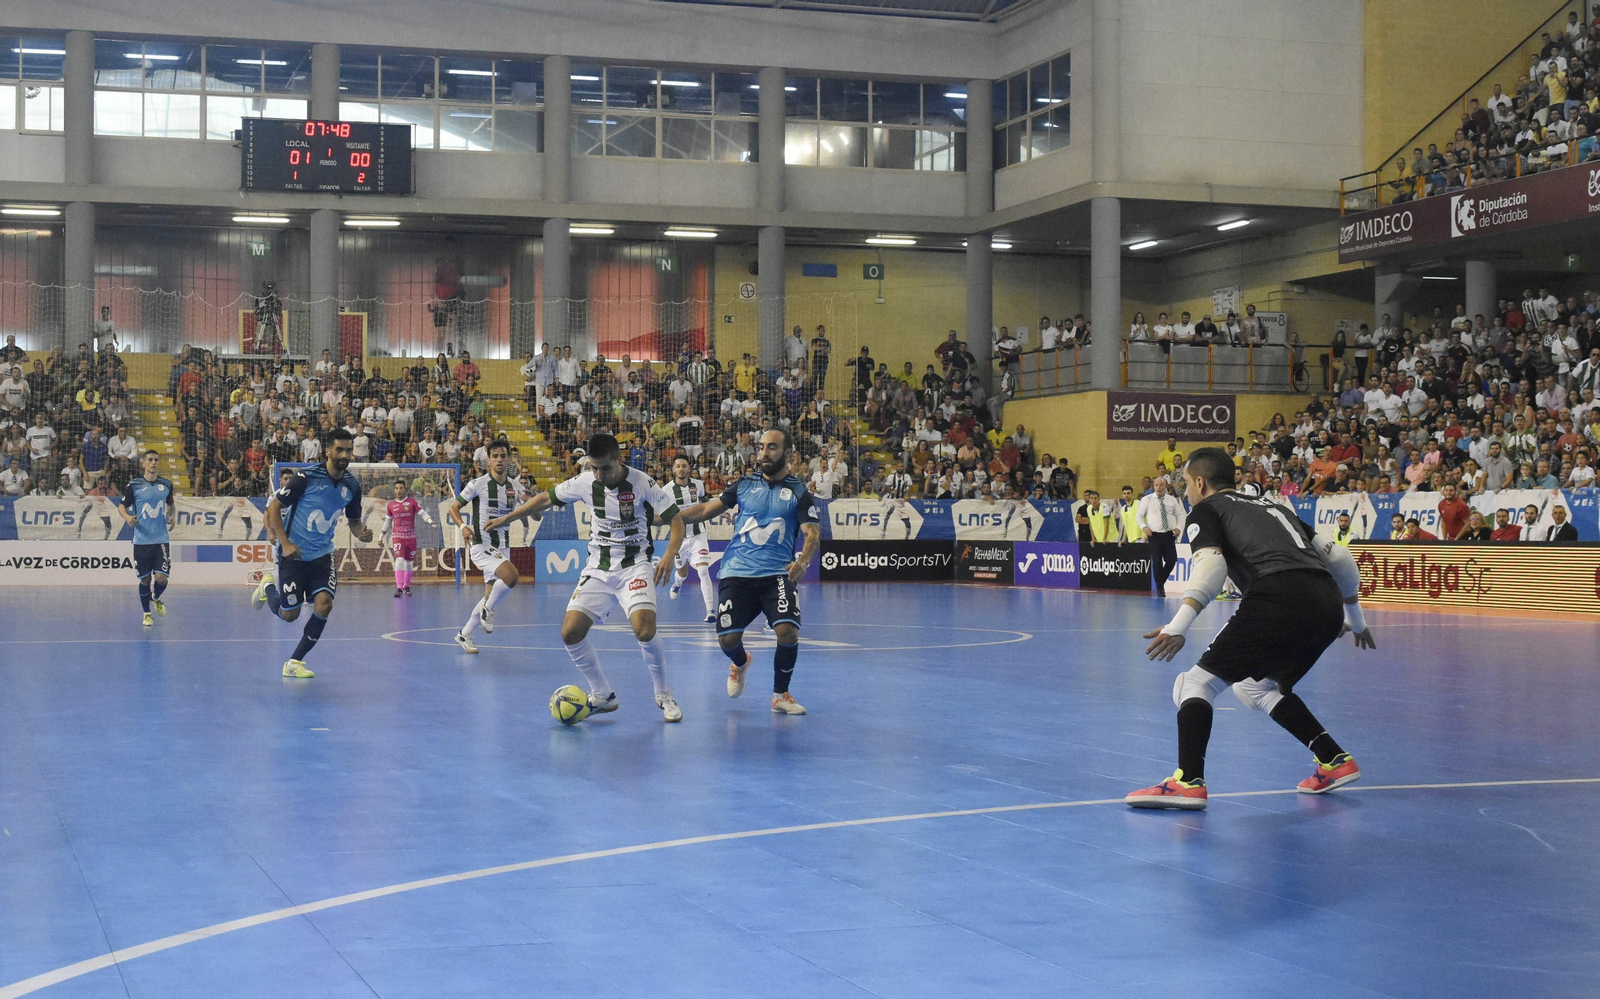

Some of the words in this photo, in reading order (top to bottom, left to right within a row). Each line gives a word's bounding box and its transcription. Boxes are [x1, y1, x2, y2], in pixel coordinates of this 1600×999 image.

[305, 121, 350, 137] 07:48
[285, 140, 310, 148] LOCAL
[346, 142, 370, 150] VISITANTE
[350, 152, 370, 168] 00
[357, 172, 366, 183] 2
[1479, 192, 1527, 213] Diputación
[1479, 216, 1491, 228] de
[1492, 208, 1528, 226] Córdoba
[1356, 210, 1413, 241] IMDECO
[252, 243, 265, 256] M
[661, 258, 671, 271] N
[1140, 402, 1231, 425] IMDECO
[1112, 425, 1138, 433] Instituto
[1138, 426, 1168, 434] Municipal
[1177, 426, 1204, 435] Deportes
[1266, 507, 1307, 550] 1
[393, 542, 402, 552] 27
[12, 556, 44, 569] VOZ
[45, 558, 58, 567] DE
